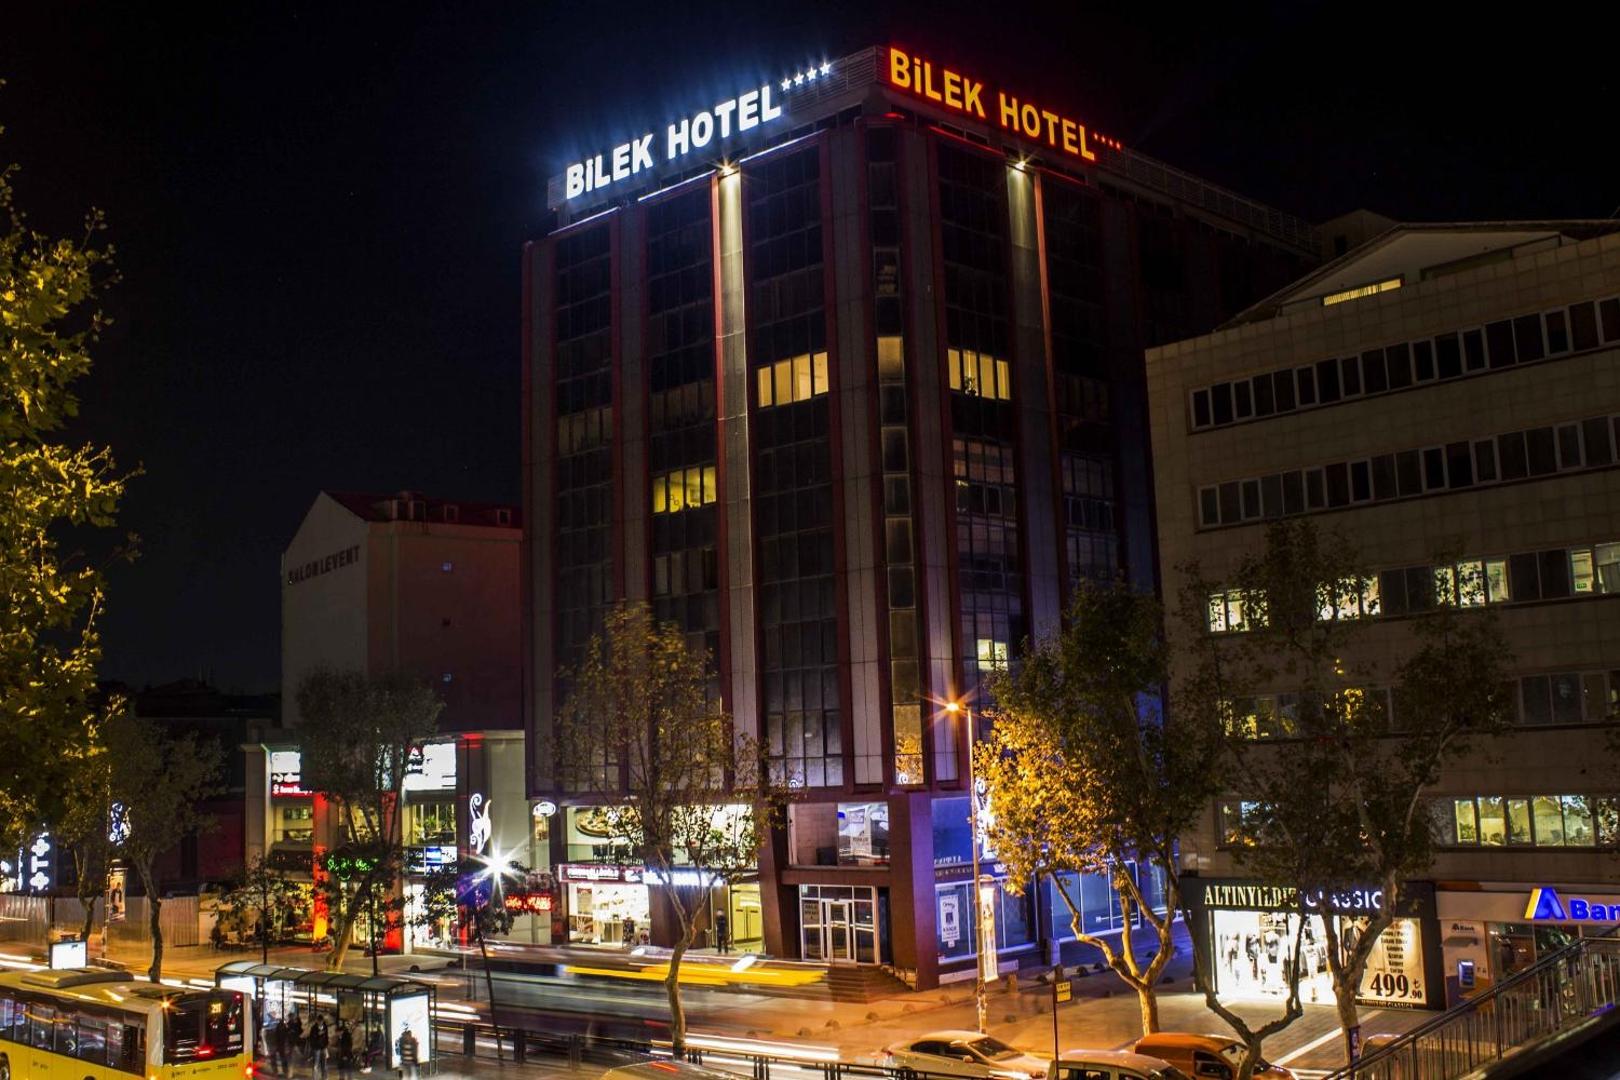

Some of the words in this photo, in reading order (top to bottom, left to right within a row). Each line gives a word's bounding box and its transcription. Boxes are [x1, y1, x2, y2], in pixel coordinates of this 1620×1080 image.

[667, 85, 781, 160] HOTEL
[1000, 92, 1095, 160] HOTEL
[1370, 973, 1409, 998] 499
